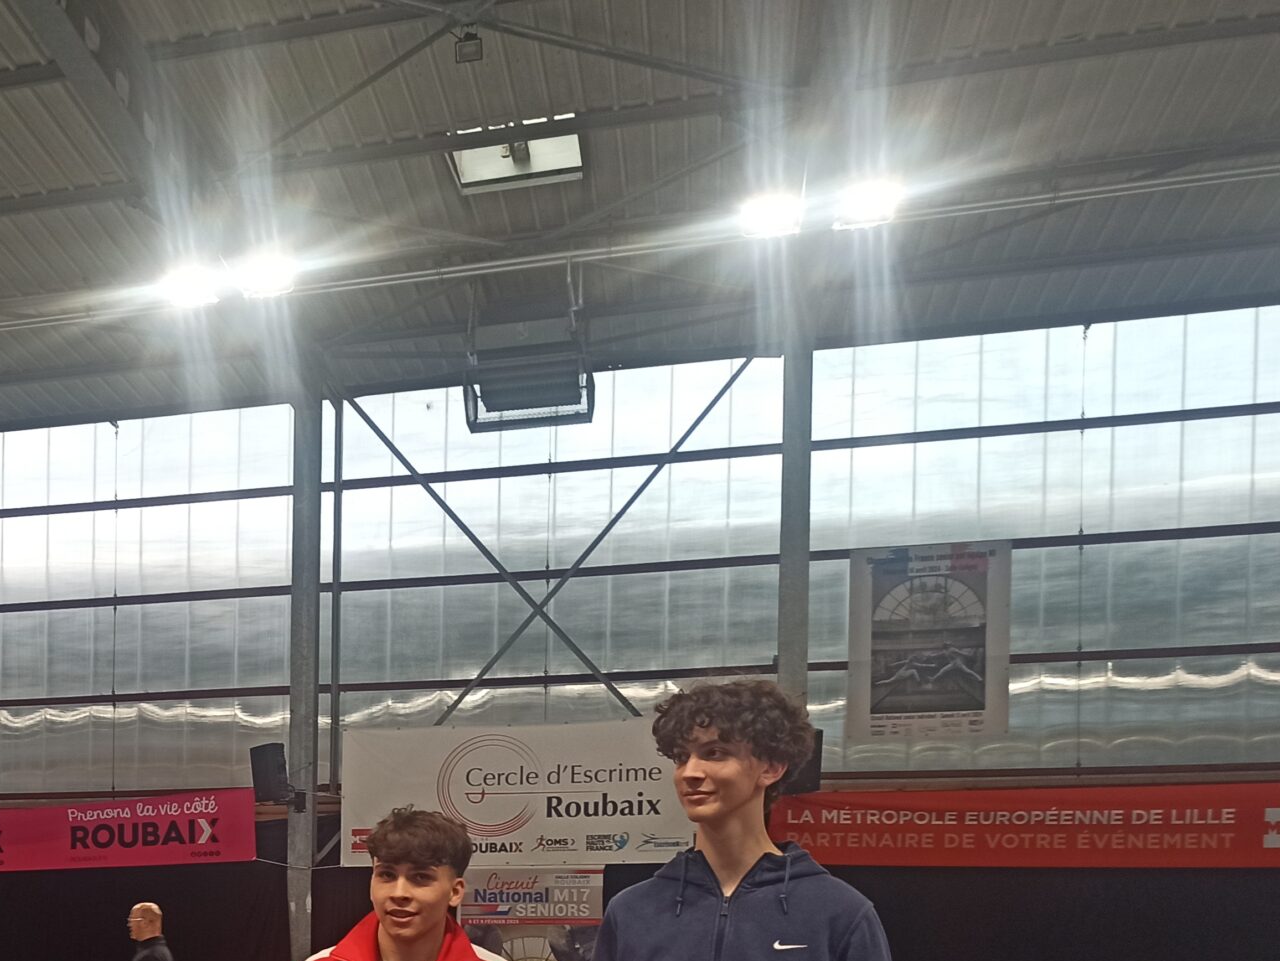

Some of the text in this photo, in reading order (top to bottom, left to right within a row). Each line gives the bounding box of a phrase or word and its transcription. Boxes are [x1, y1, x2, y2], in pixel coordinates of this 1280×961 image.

[465, 763, 663, 787] Cercle d'Escrime
[67, 796, 218, 822] Prenons la vie côté
[545, 791, 662, 818] Roubaix
[786, 806, 1236, 825] LA MÉTROPOLE EUROPÉENNE DE LILLE
[70, 818, 220, 850] ROUBAIX
[545, 838, 569, 847] OMS
[786, 829, 1236, 849] PARTENAIRE DE VOTRE ÉVÉNEMENT
[472, 842, 524, 853] OUBAIX
[486, 872, 539, 891] Circuit
[473, 887, 591, 904] National M17
[515, 903, 591, 917] SENIORS
